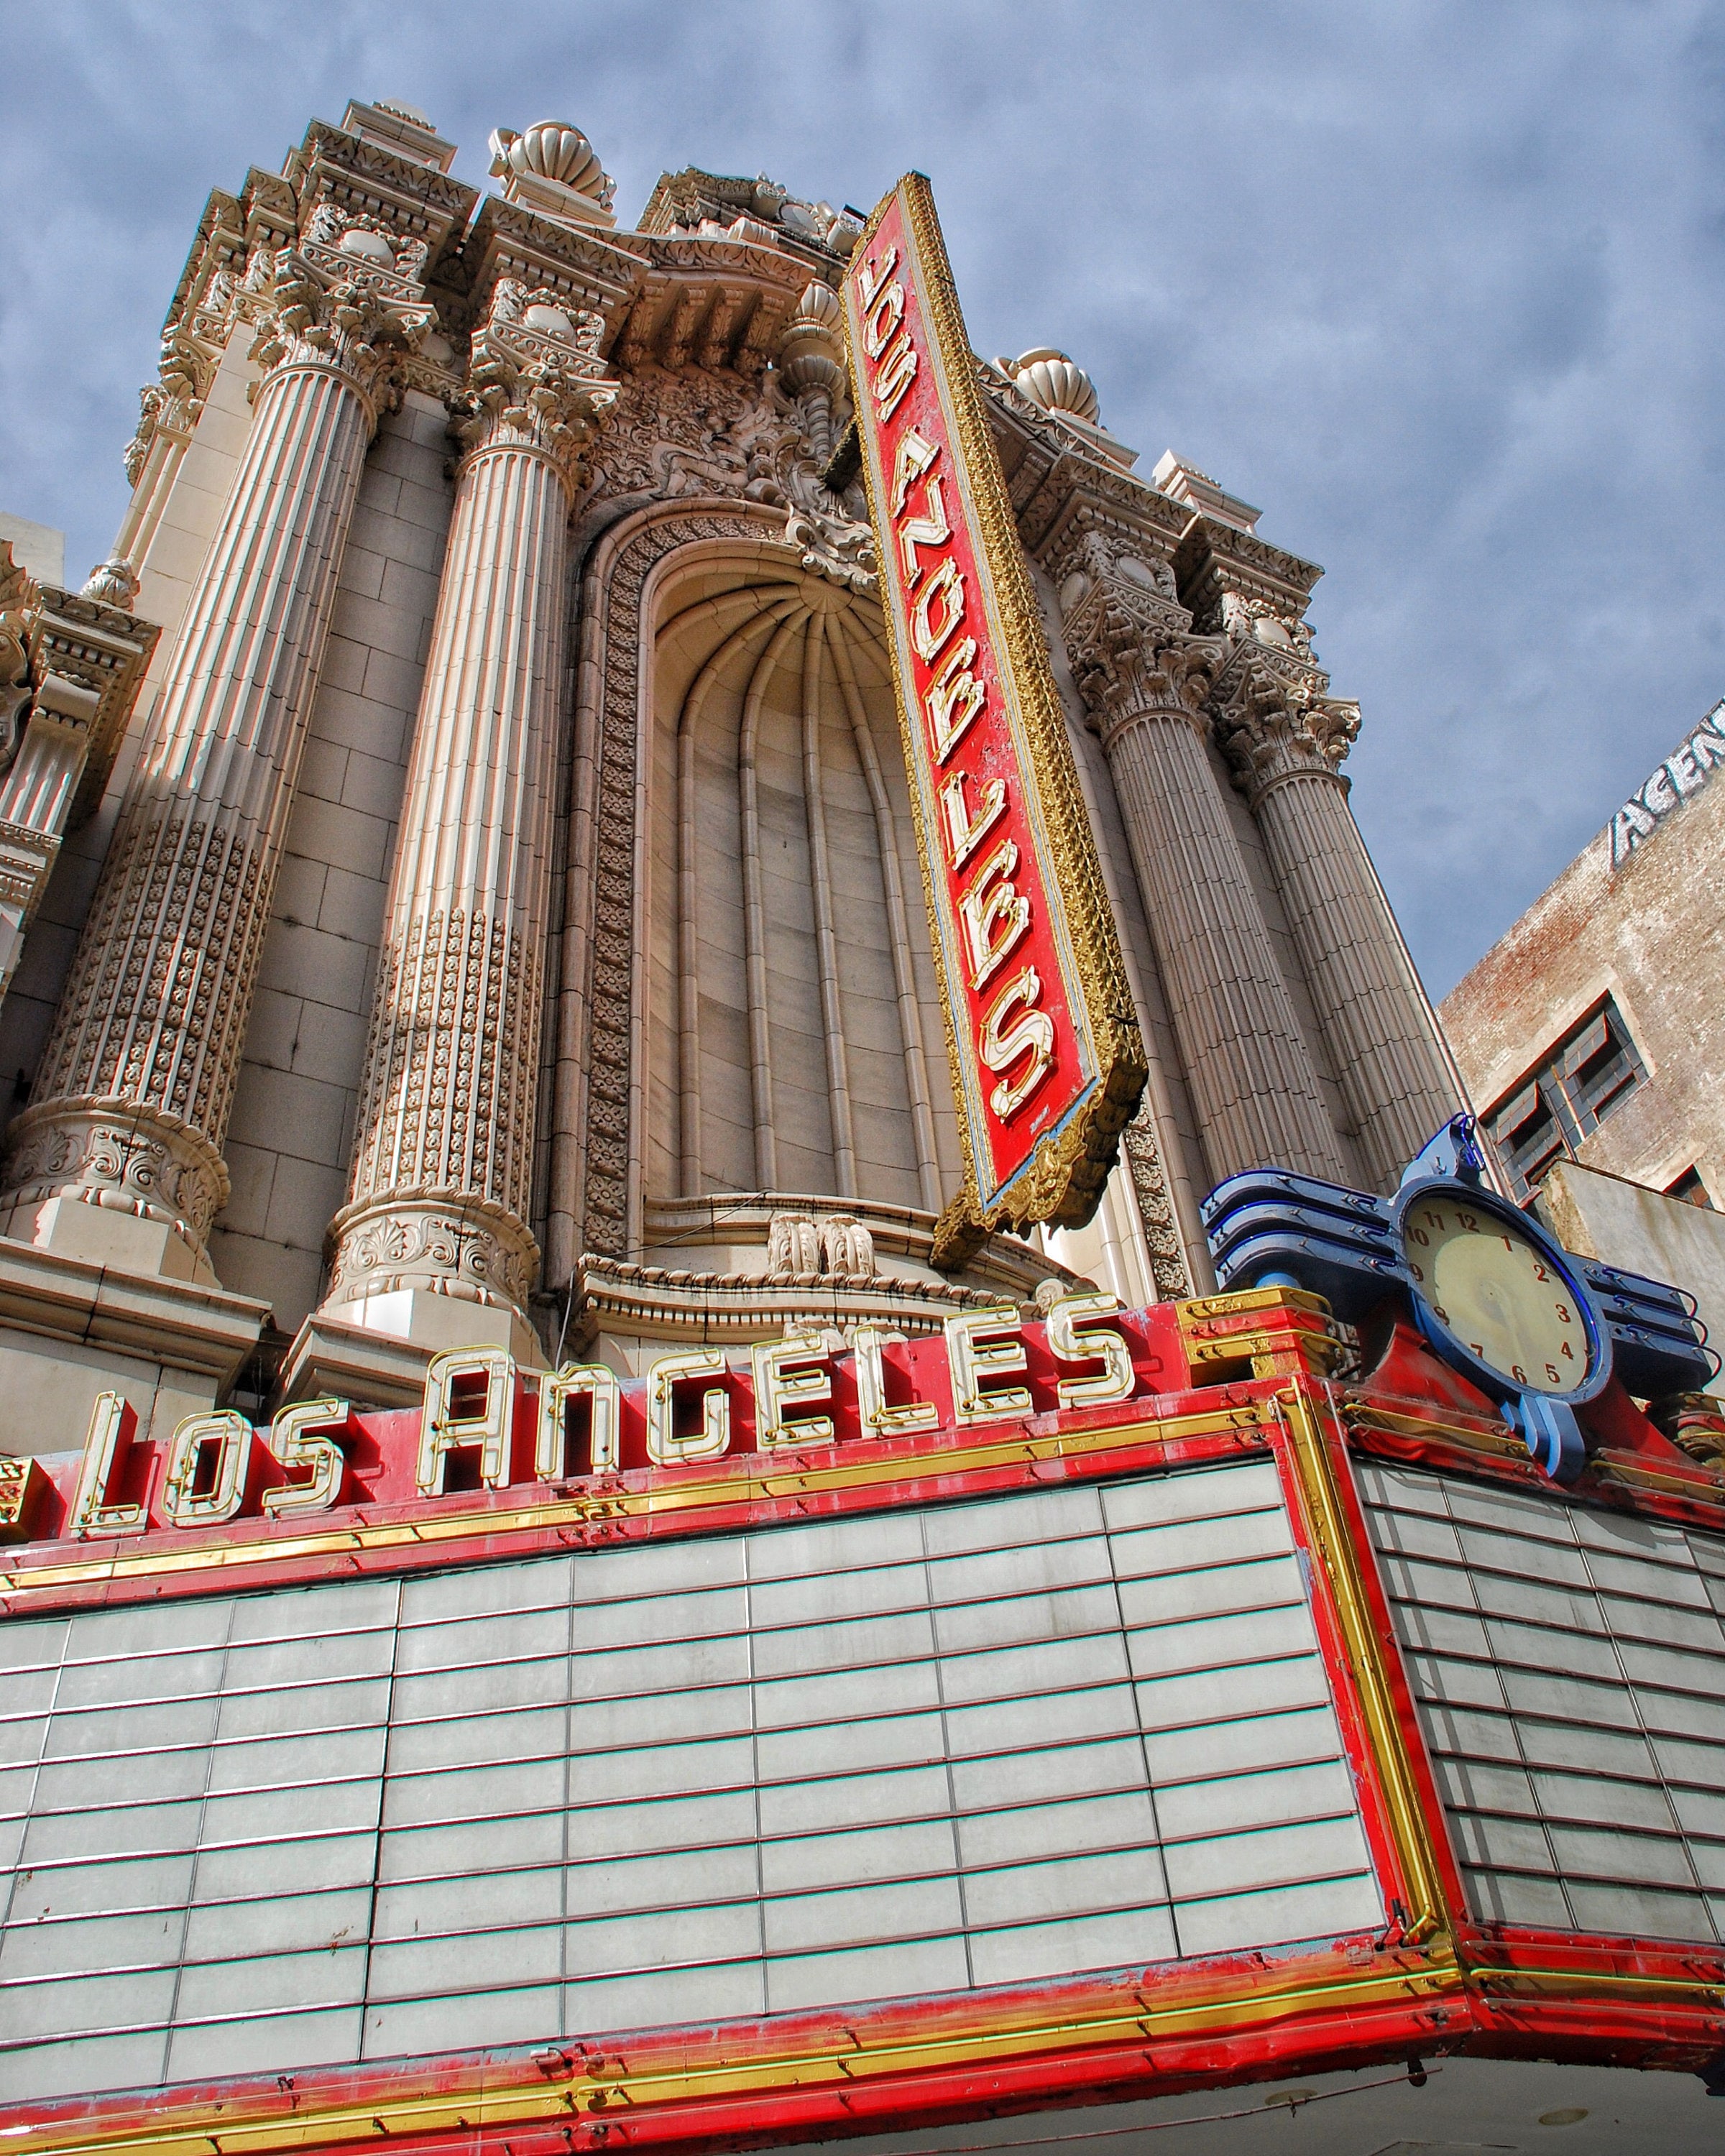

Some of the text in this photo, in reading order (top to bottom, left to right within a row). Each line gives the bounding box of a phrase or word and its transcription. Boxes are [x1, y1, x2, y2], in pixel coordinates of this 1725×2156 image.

[856, 242, 1054, 1124] LOS ANGELES
[1423, 1210, 1445, 1231] 11
[1455, 1212, 1480, 1233] 12
[1407, 1225, 1430, 1246] 10
[1501, 1235, 1513, 1252] 1
[1410, 1263, 1424, 1281] 9
[1533, 1263, 1550, 1283] 2
[1433, 1305, 1450, 1326] 8
[1555, 1304, 1571, 1323] 3
[1470, 1342, 1484, 1359] 7
[1560, 1341, 1574, 1360] 4
[1512, 1365, 1527, 1385] 6
[1545, 1363, 1560, 1383] 5
[68, 1291, 1136, 1538] LOS ANGELES
